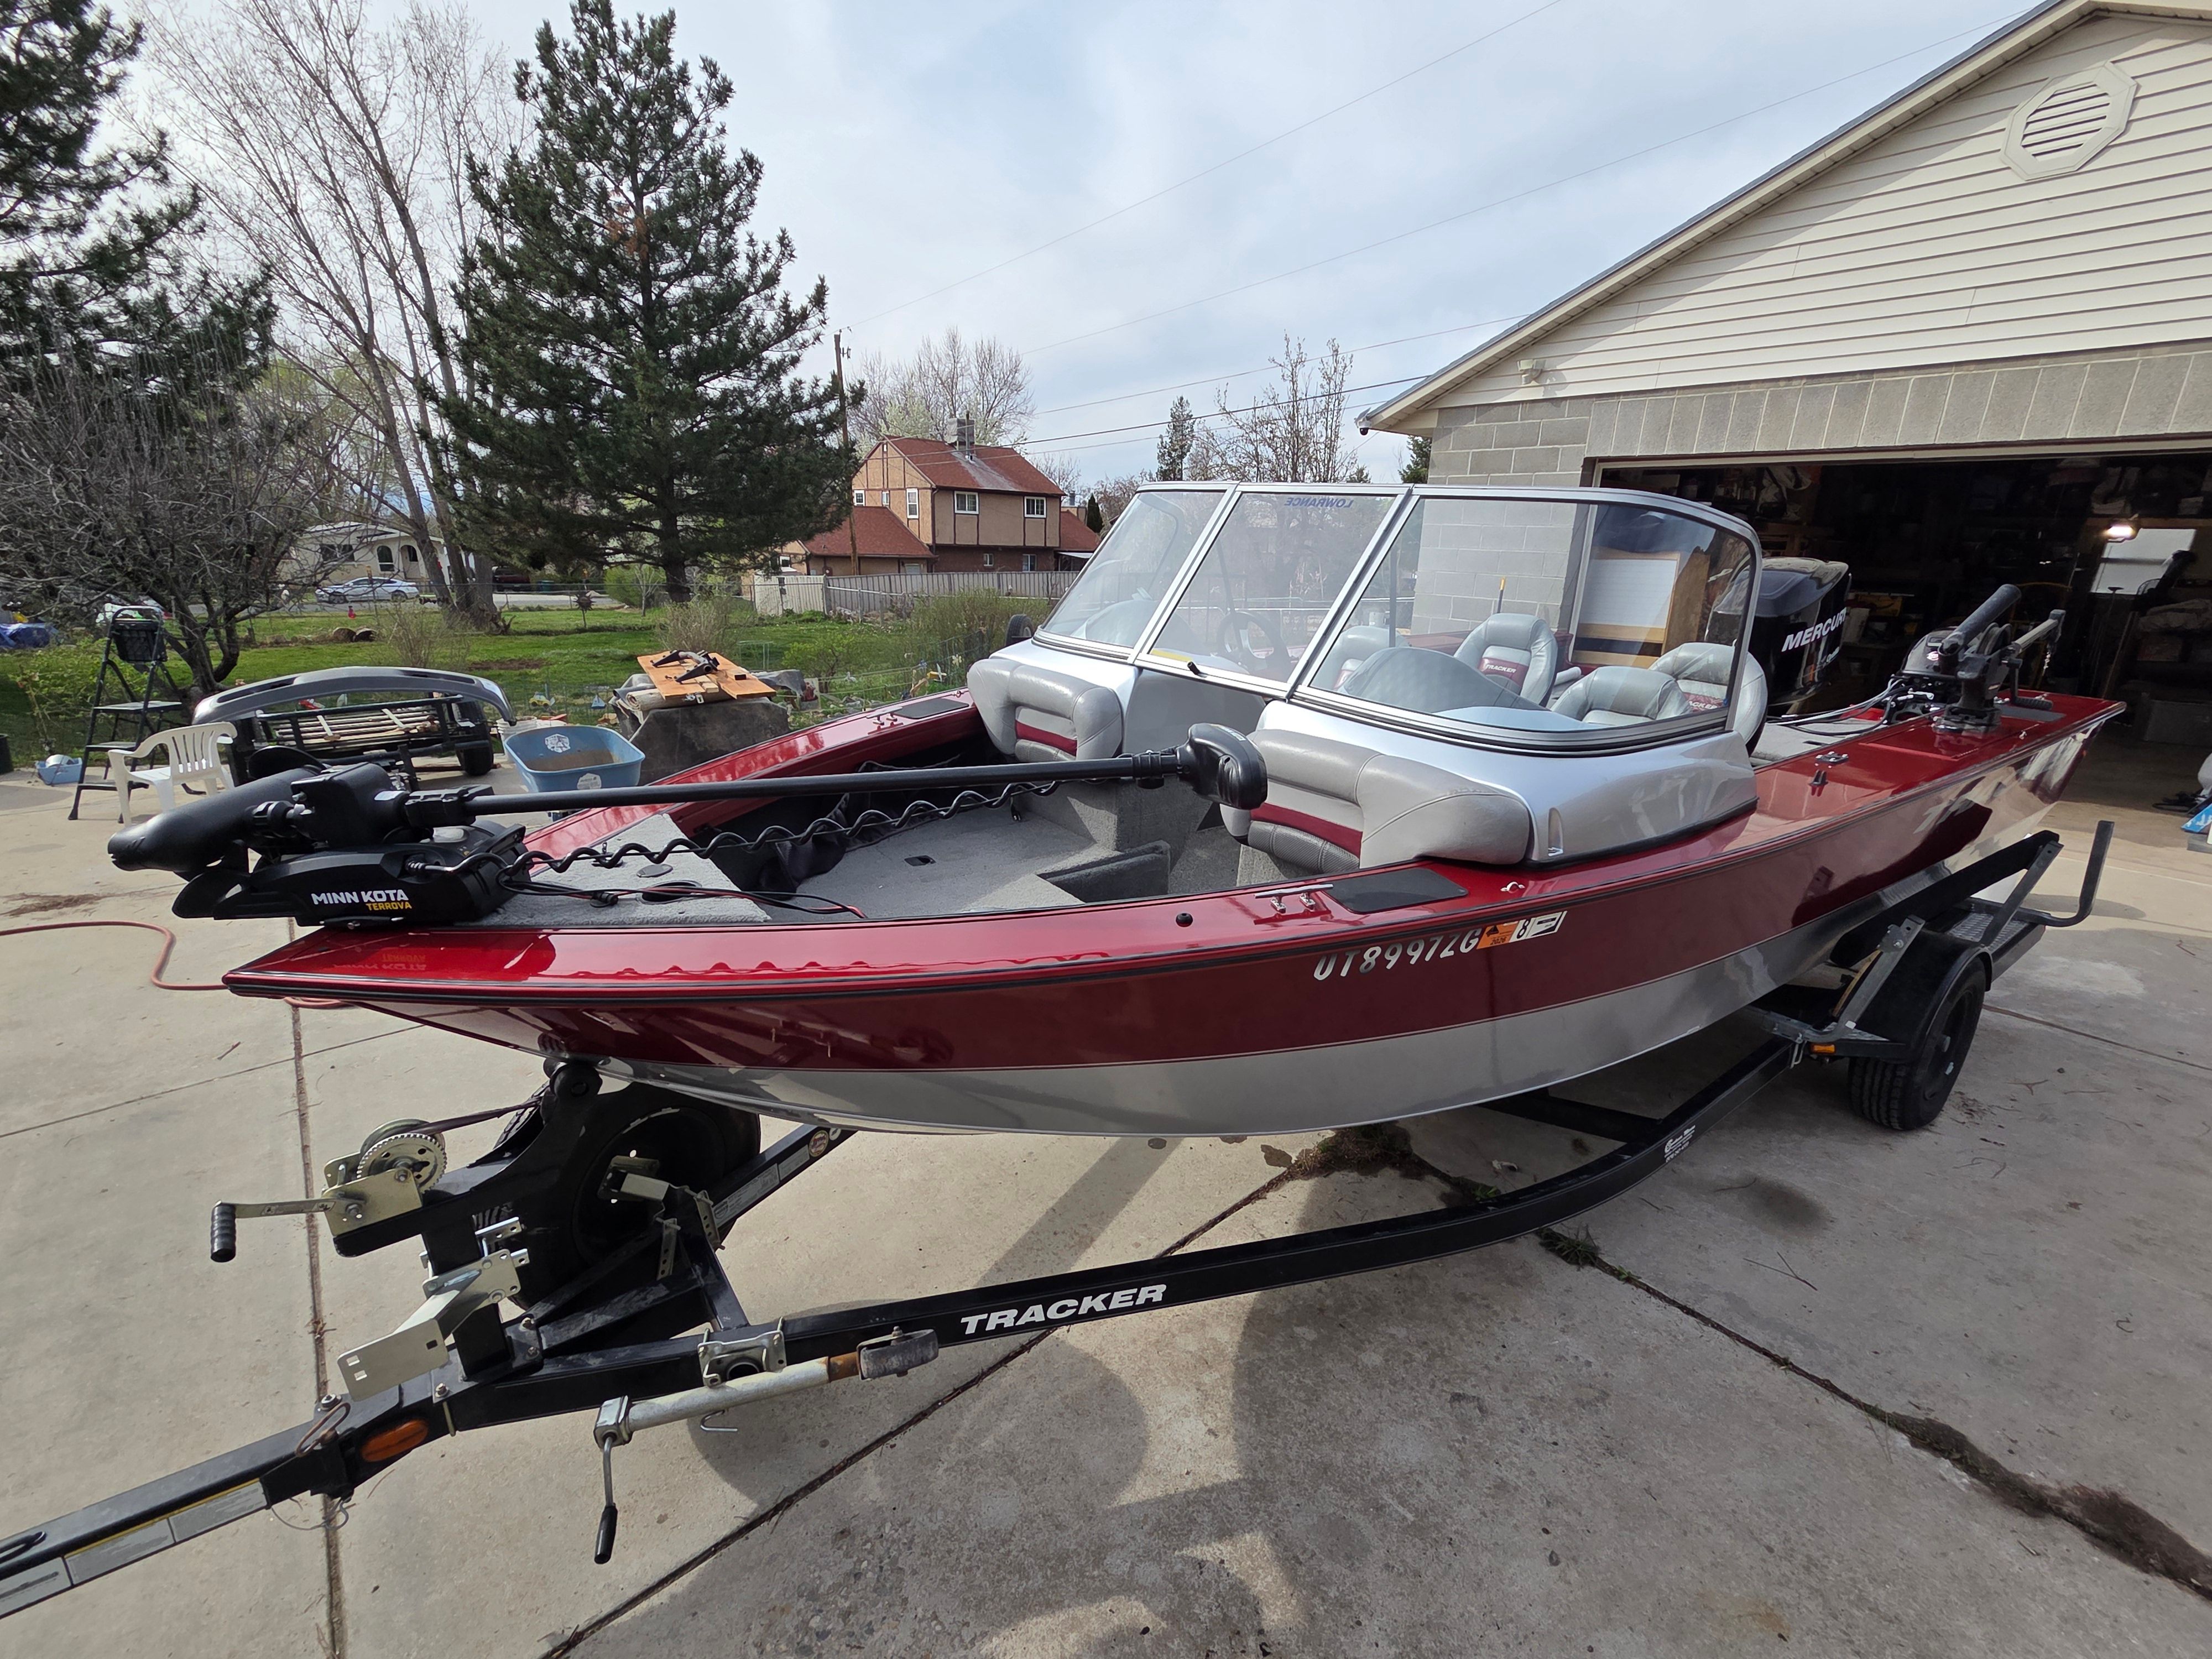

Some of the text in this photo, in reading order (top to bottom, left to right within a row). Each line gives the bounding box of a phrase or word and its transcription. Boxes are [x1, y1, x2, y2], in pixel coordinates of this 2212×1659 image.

[1486, 664, 1516, 673] TRACKER
[311, 889, 409, 904] MINN KOTA
[366, 901, 412, 911] TERROVA
[961, 1284, 1167, 1335] TRACKER
